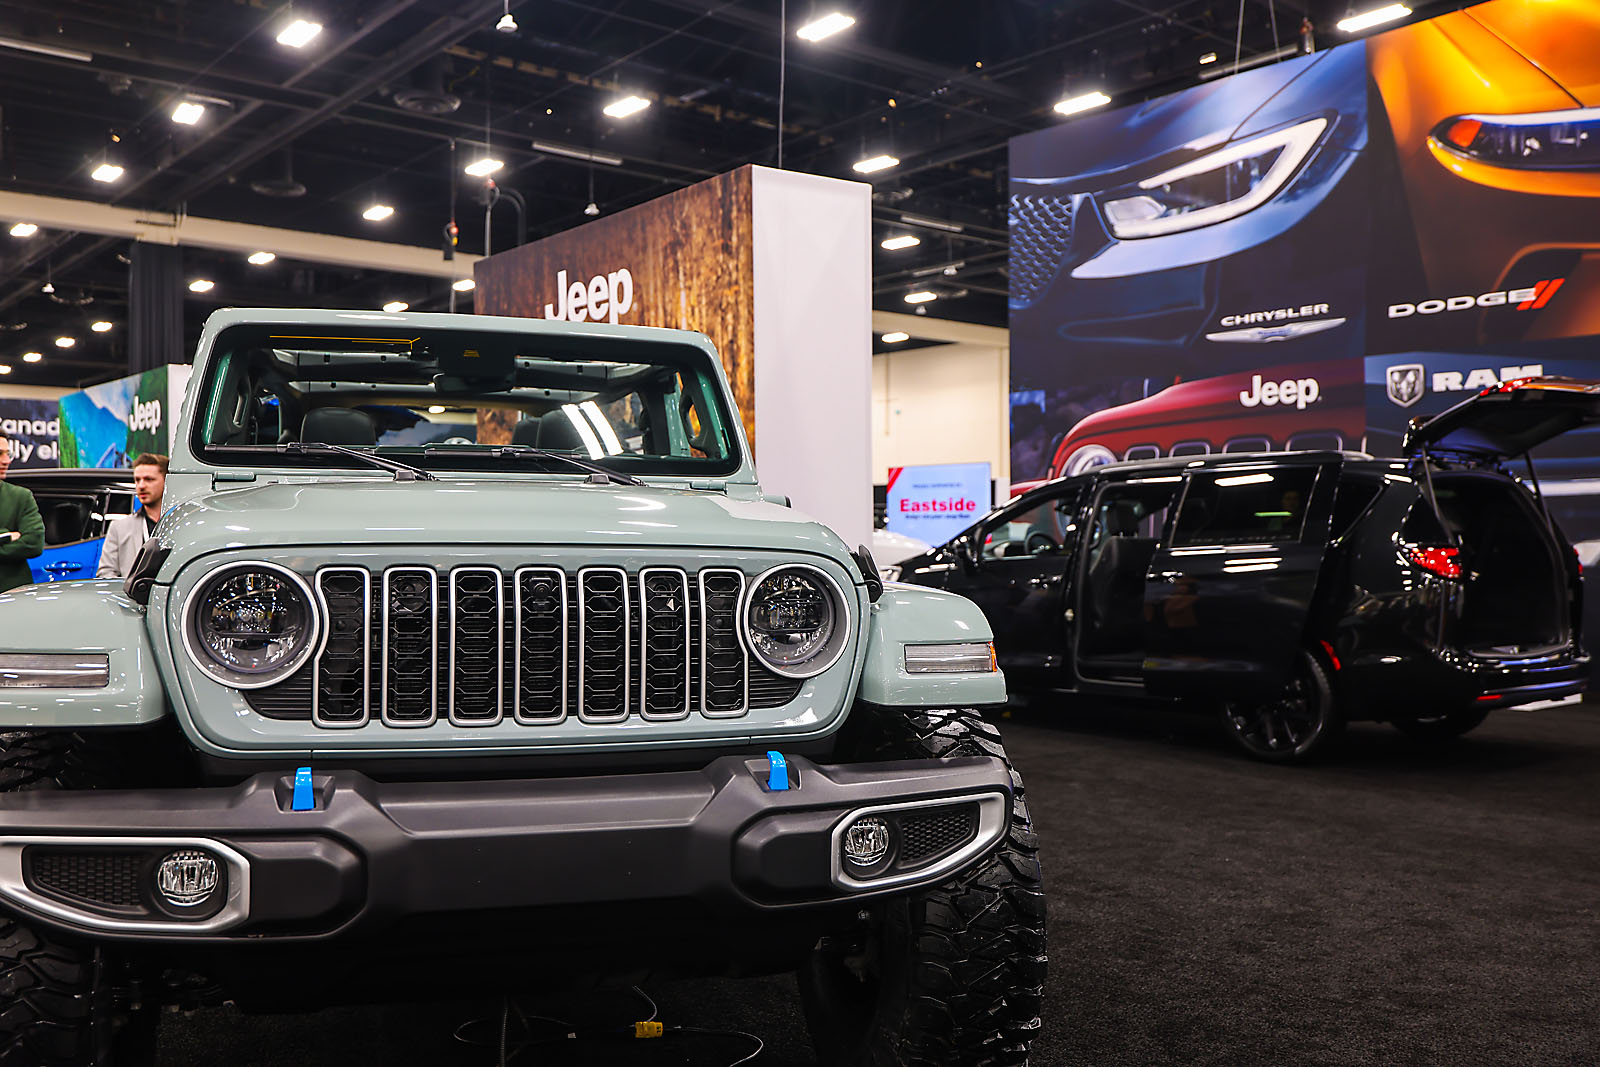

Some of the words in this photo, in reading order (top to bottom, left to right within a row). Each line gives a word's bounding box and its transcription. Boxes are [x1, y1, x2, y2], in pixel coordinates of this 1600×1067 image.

[545, 268, 634, 325] Jeep
[1388, 287, 1537, 319] DODGE
[1220, 303, 1330, 327] CHRYSLER
[1239, 374, 1320, 410] Jeep
[1432, 364, 1544, 393] RAM
[129, 395, 161, 435] Jeep
[899, 497, 977, 513] Eastside
